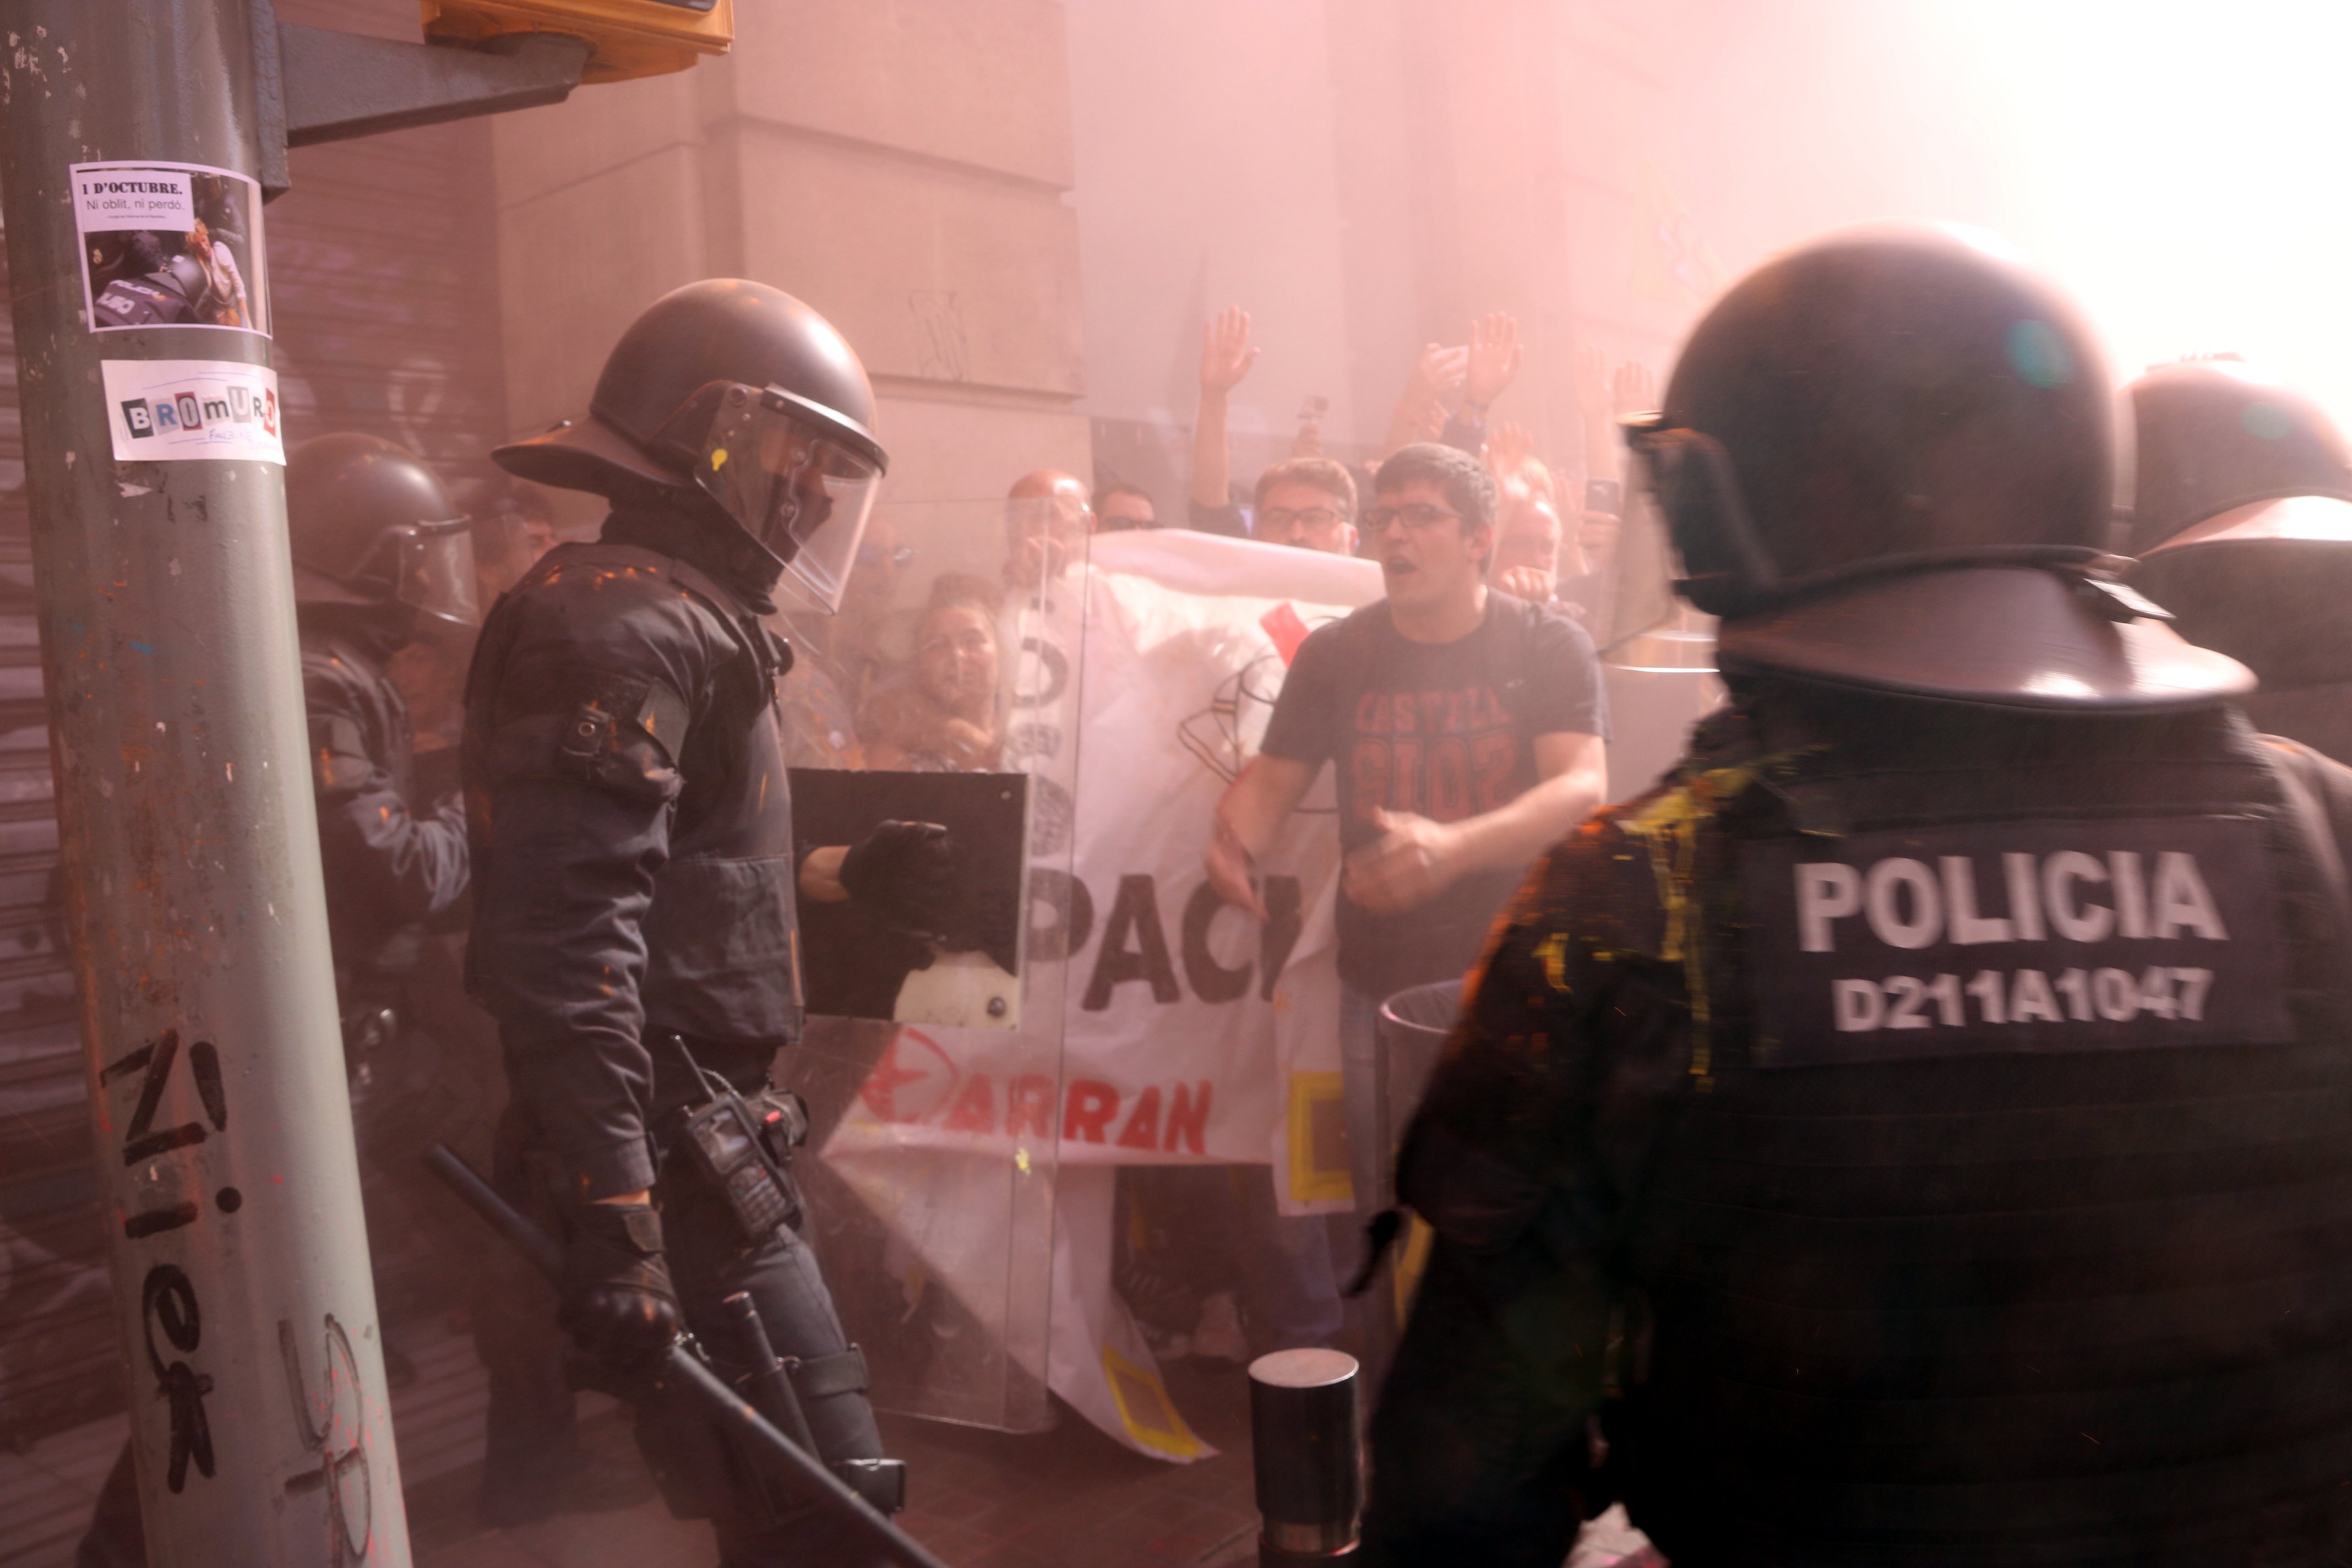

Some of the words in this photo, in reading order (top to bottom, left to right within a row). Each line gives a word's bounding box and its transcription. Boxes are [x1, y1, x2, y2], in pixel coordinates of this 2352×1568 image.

[86, 200, 99, 210] Ni
[134, 199, 145, 208] ni
[1793, 850, 2230, 952] POLICIA
[1832, 966, 2214, 1031] D211A1047
[942, 1073, 1214, 1155] ARRAN
